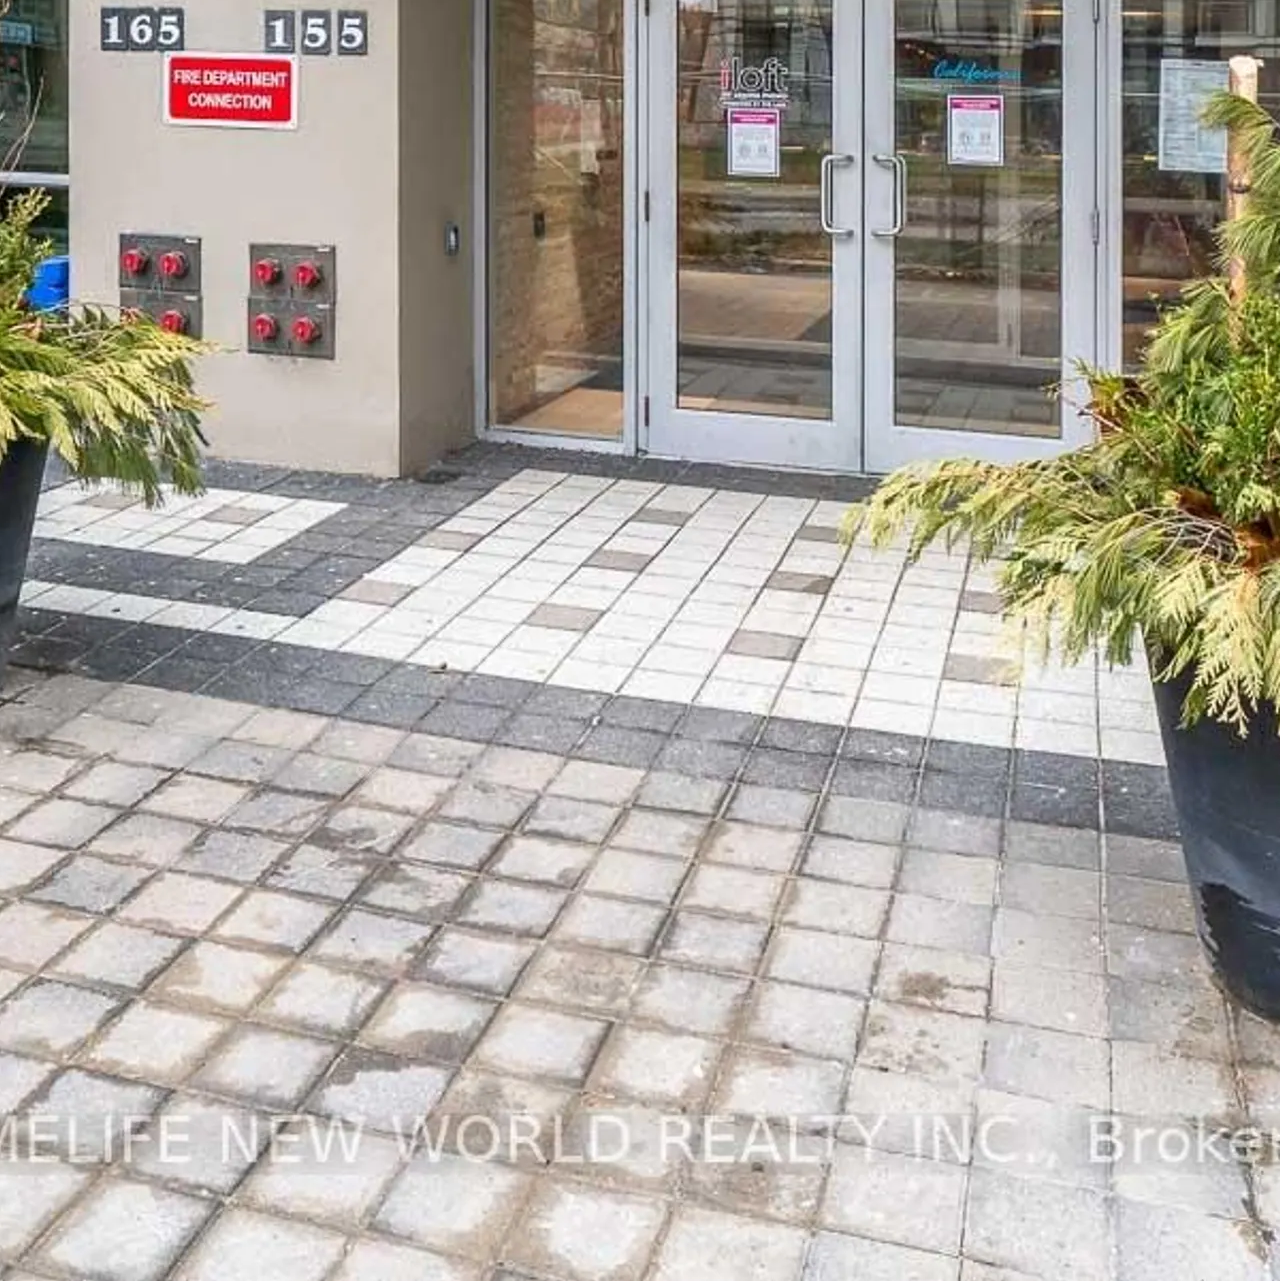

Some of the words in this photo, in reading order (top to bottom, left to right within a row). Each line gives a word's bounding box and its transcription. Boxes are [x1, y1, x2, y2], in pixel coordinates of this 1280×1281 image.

[102, 15, 180, 45] 165
[268, 16, 365, 49] 155
[173, 68, 202, 86] FIRE
[202, 69, 288, 89] DEPARTMENT
[187, 92, 272, 111] CONNECTION
